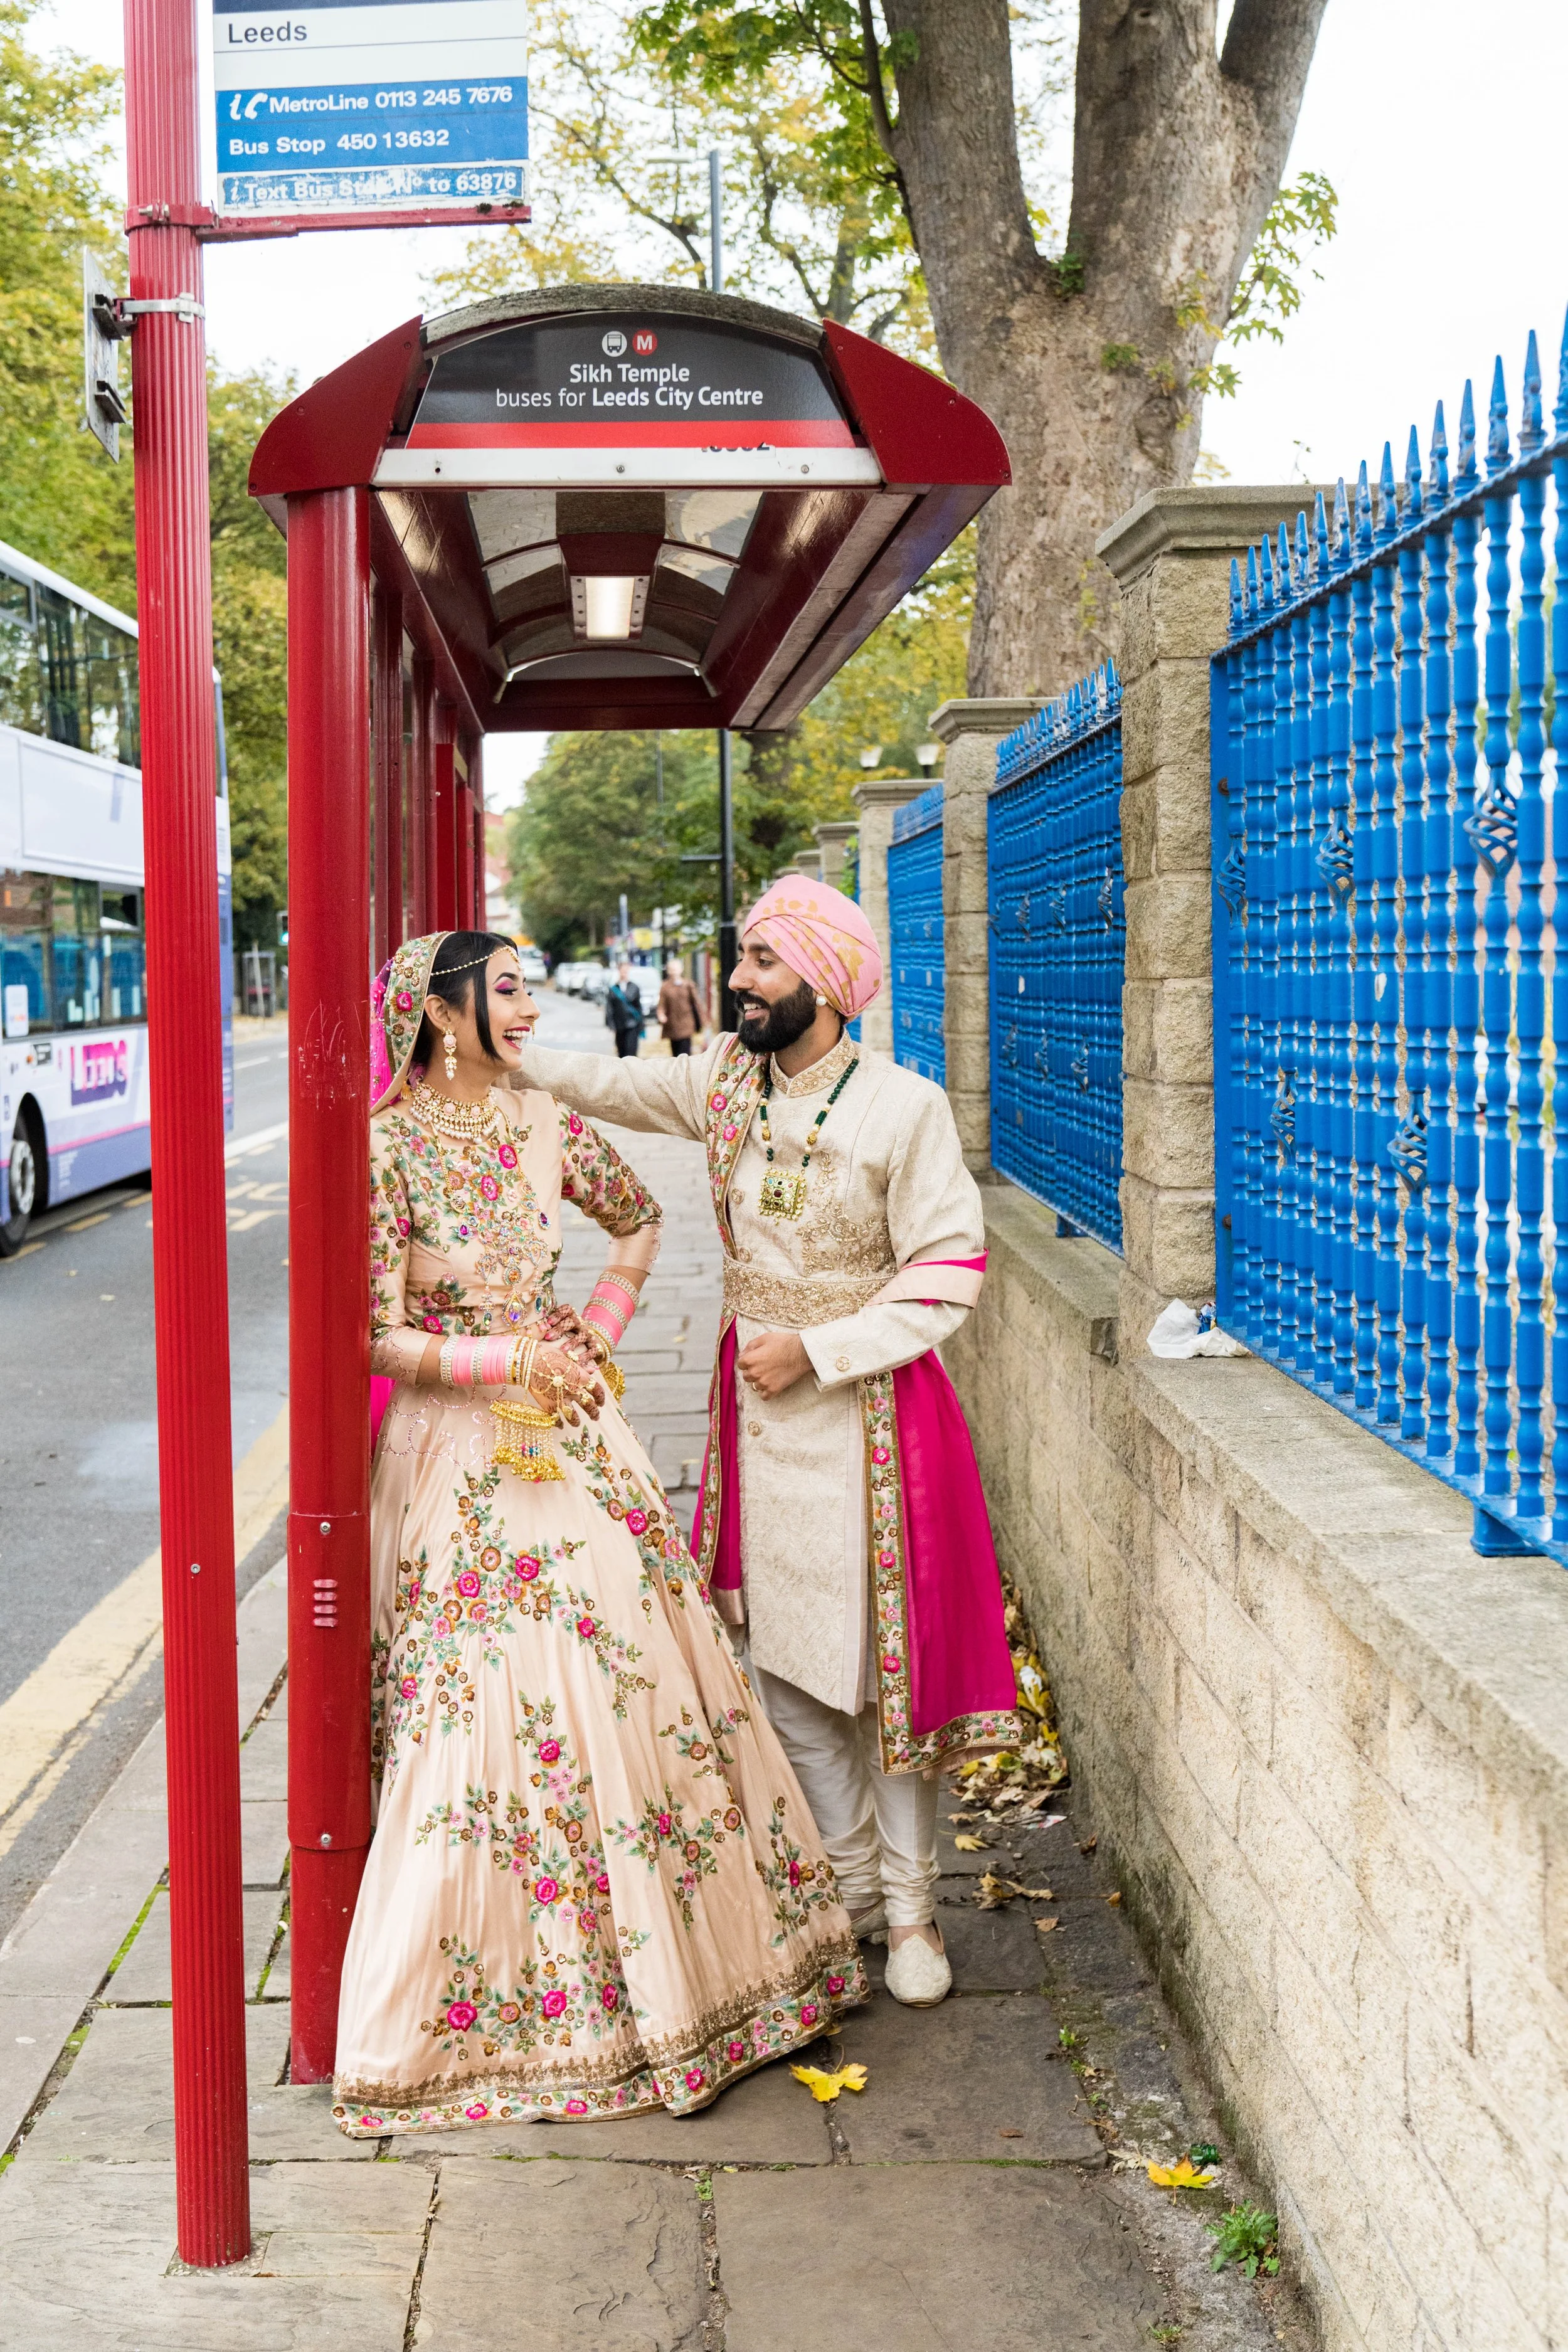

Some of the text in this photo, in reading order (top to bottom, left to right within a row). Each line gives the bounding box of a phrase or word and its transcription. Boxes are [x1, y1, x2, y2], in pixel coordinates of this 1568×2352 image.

[228, 21, 307, 43] Leeds
[270, 93, 369, 114] MetroLine
[375, 90, 417, 109] 0113
[423, 88, 461, 105] 245
[466, 86, 513, 104] 7676
[230, 139, 269, 156] Bus
[276, 136, 326, 156] Stop
[244, 183, 288, 201] Text
[294, 181, 333, 199] Bus
[428, 177, 450, 193] to
[456, 172, 517, 191] 63876
[637, 335, 653, 351] M
[569, 363, 690, 386] Sikh Temple
[496, 386, 763, 410] buses for Leeds City Centre
